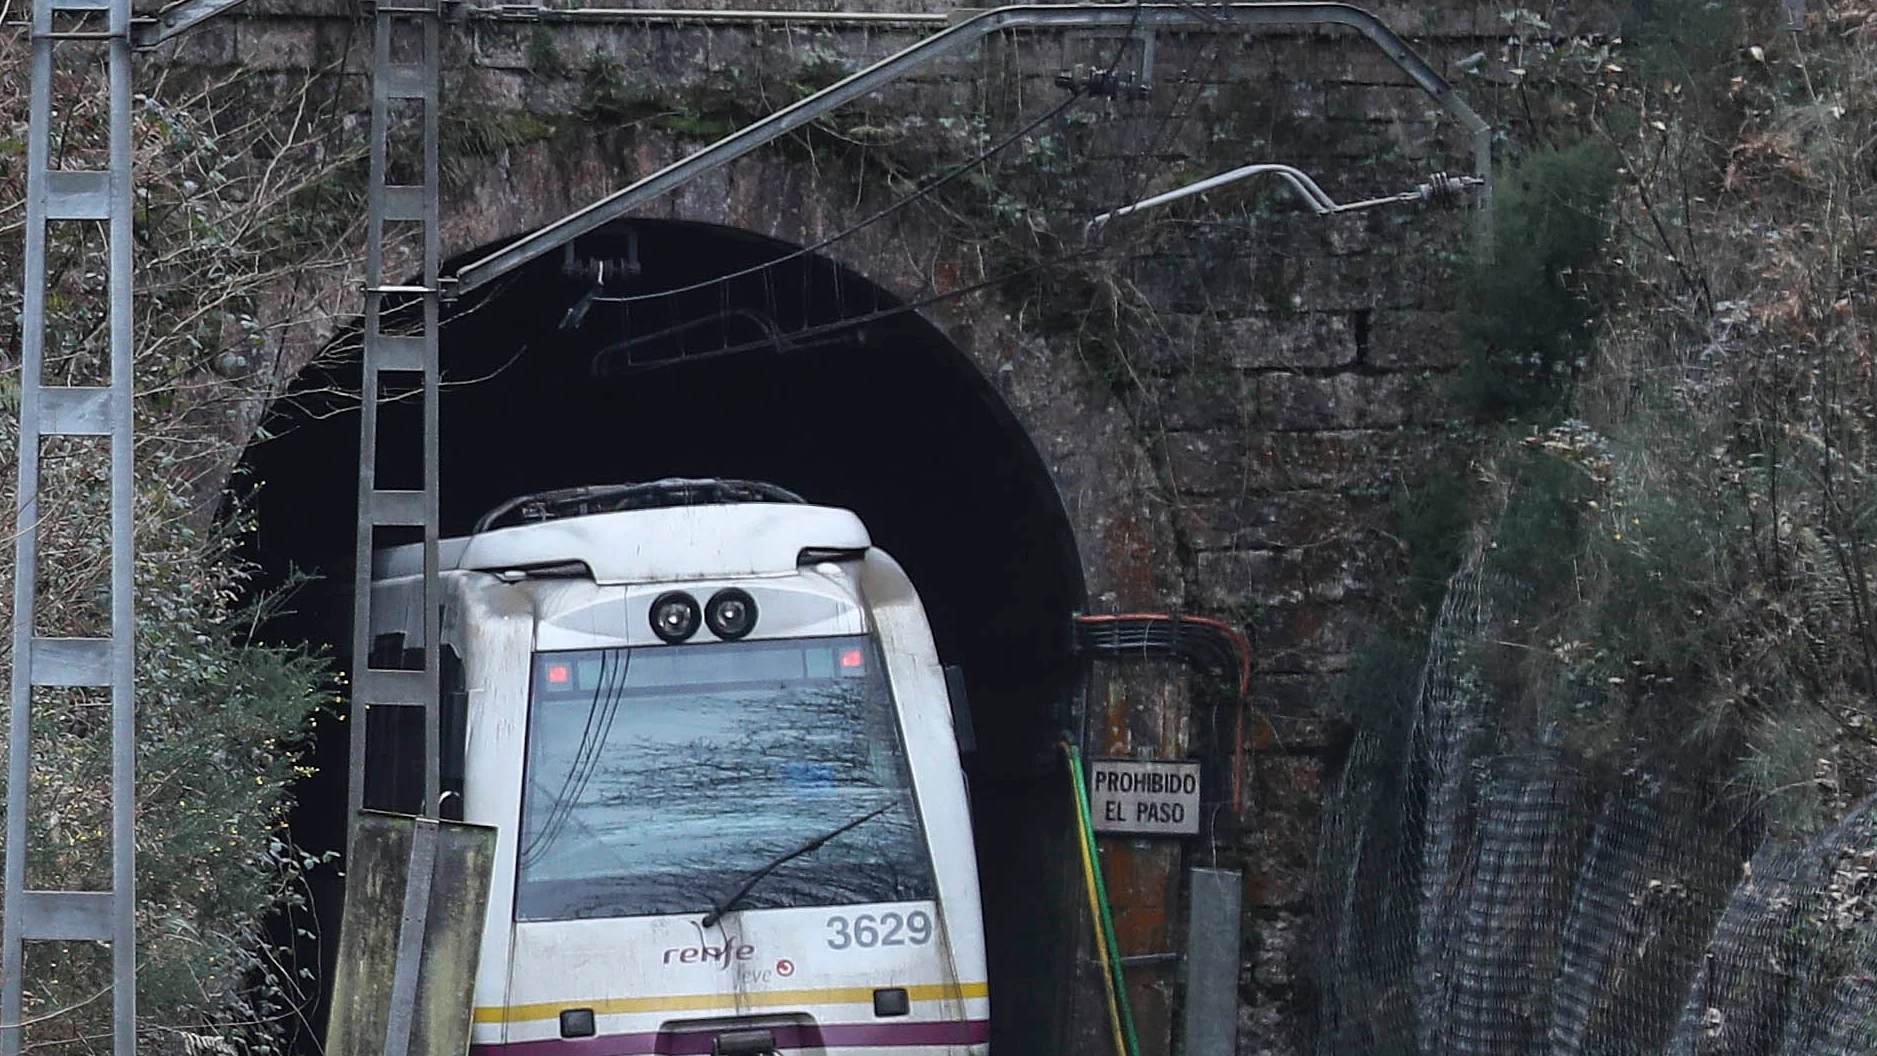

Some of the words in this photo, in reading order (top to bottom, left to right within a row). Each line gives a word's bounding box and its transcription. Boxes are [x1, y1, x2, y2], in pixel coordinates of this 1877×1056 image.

[1095, 771, 1197, 794] PROHIBIDO
[1105, 801, 1126, 821] EL
[1137, 802, 1185, 823] PASO
[826, 910, 933, 950] 3629
[663, 936, 755, 971] renfe
